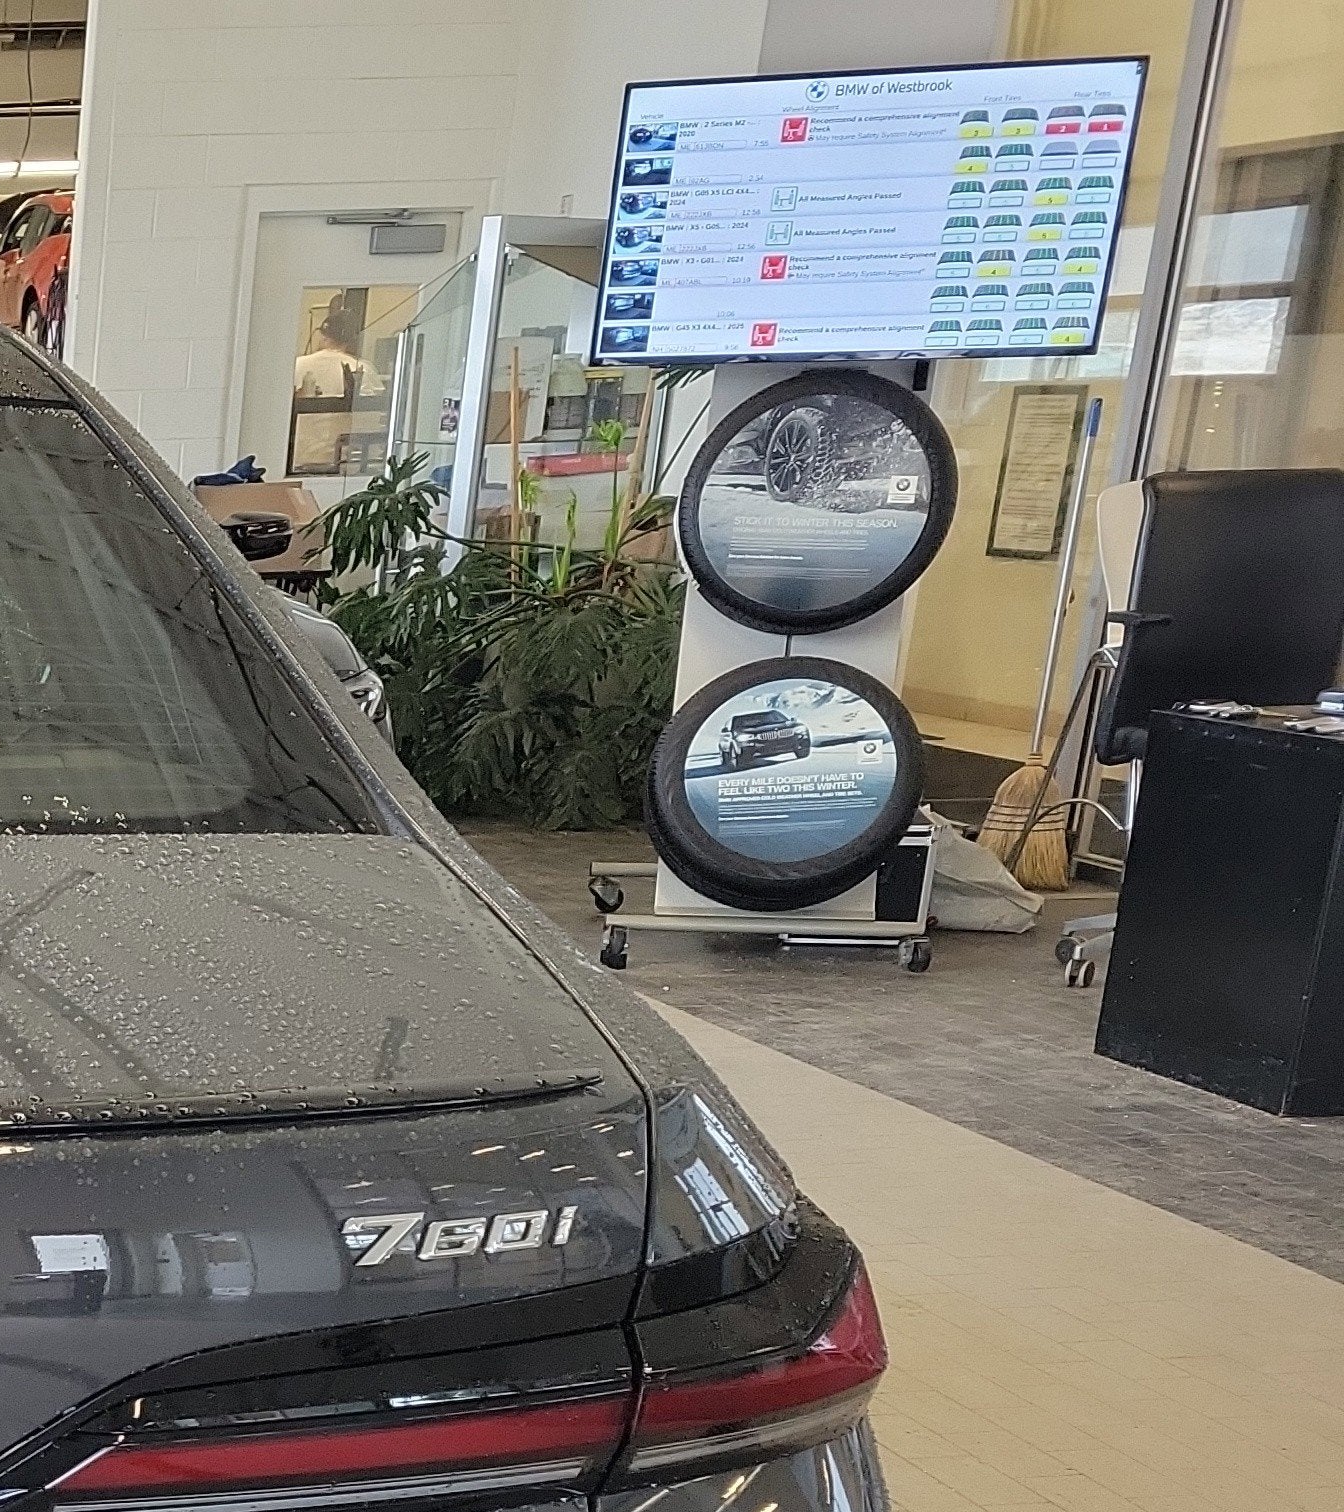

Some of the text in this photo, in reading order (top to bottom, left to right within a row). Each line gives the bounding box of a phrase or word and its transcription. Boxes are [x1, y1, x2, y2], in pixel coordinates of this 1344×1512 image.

[835, 79, 953, 97] BMW of Westbrook
[810, 116, 857, 124] Recommend
[864, 113, 921, 122] comprehensive
[922, 111, 960, 120] alignment
[680, 121, 698, 129] BMW
[711, 120, 733, 128] Series
[679, 130, 695, 138] 2020
[810, 194, 846, 202] Measured
[847, 192, 873, 201] Angles
[842, 228, 867, 236] Angles
[789, 254, 835, 262] Recommend
[842, 252, 899, 261] comprehensive
[900, 251, 937, 260] alignment
[778, 326, 824, 334] Recommend
[831, 325, 887, 333] comprehensive
[888, 324, 925, 332] alignment
[734, 516, 761, 526] STICK
[777, 517, 789, 526] TO
[792, 517, 829, 527] WINTER
[833, 518, 854, 528] THIS
[718, 772, 864, 788] EVERY MILE DOESN'T HAVE TO
[718, 781, 858, 796] FEEL LIKE TWO THIS WINTER.
